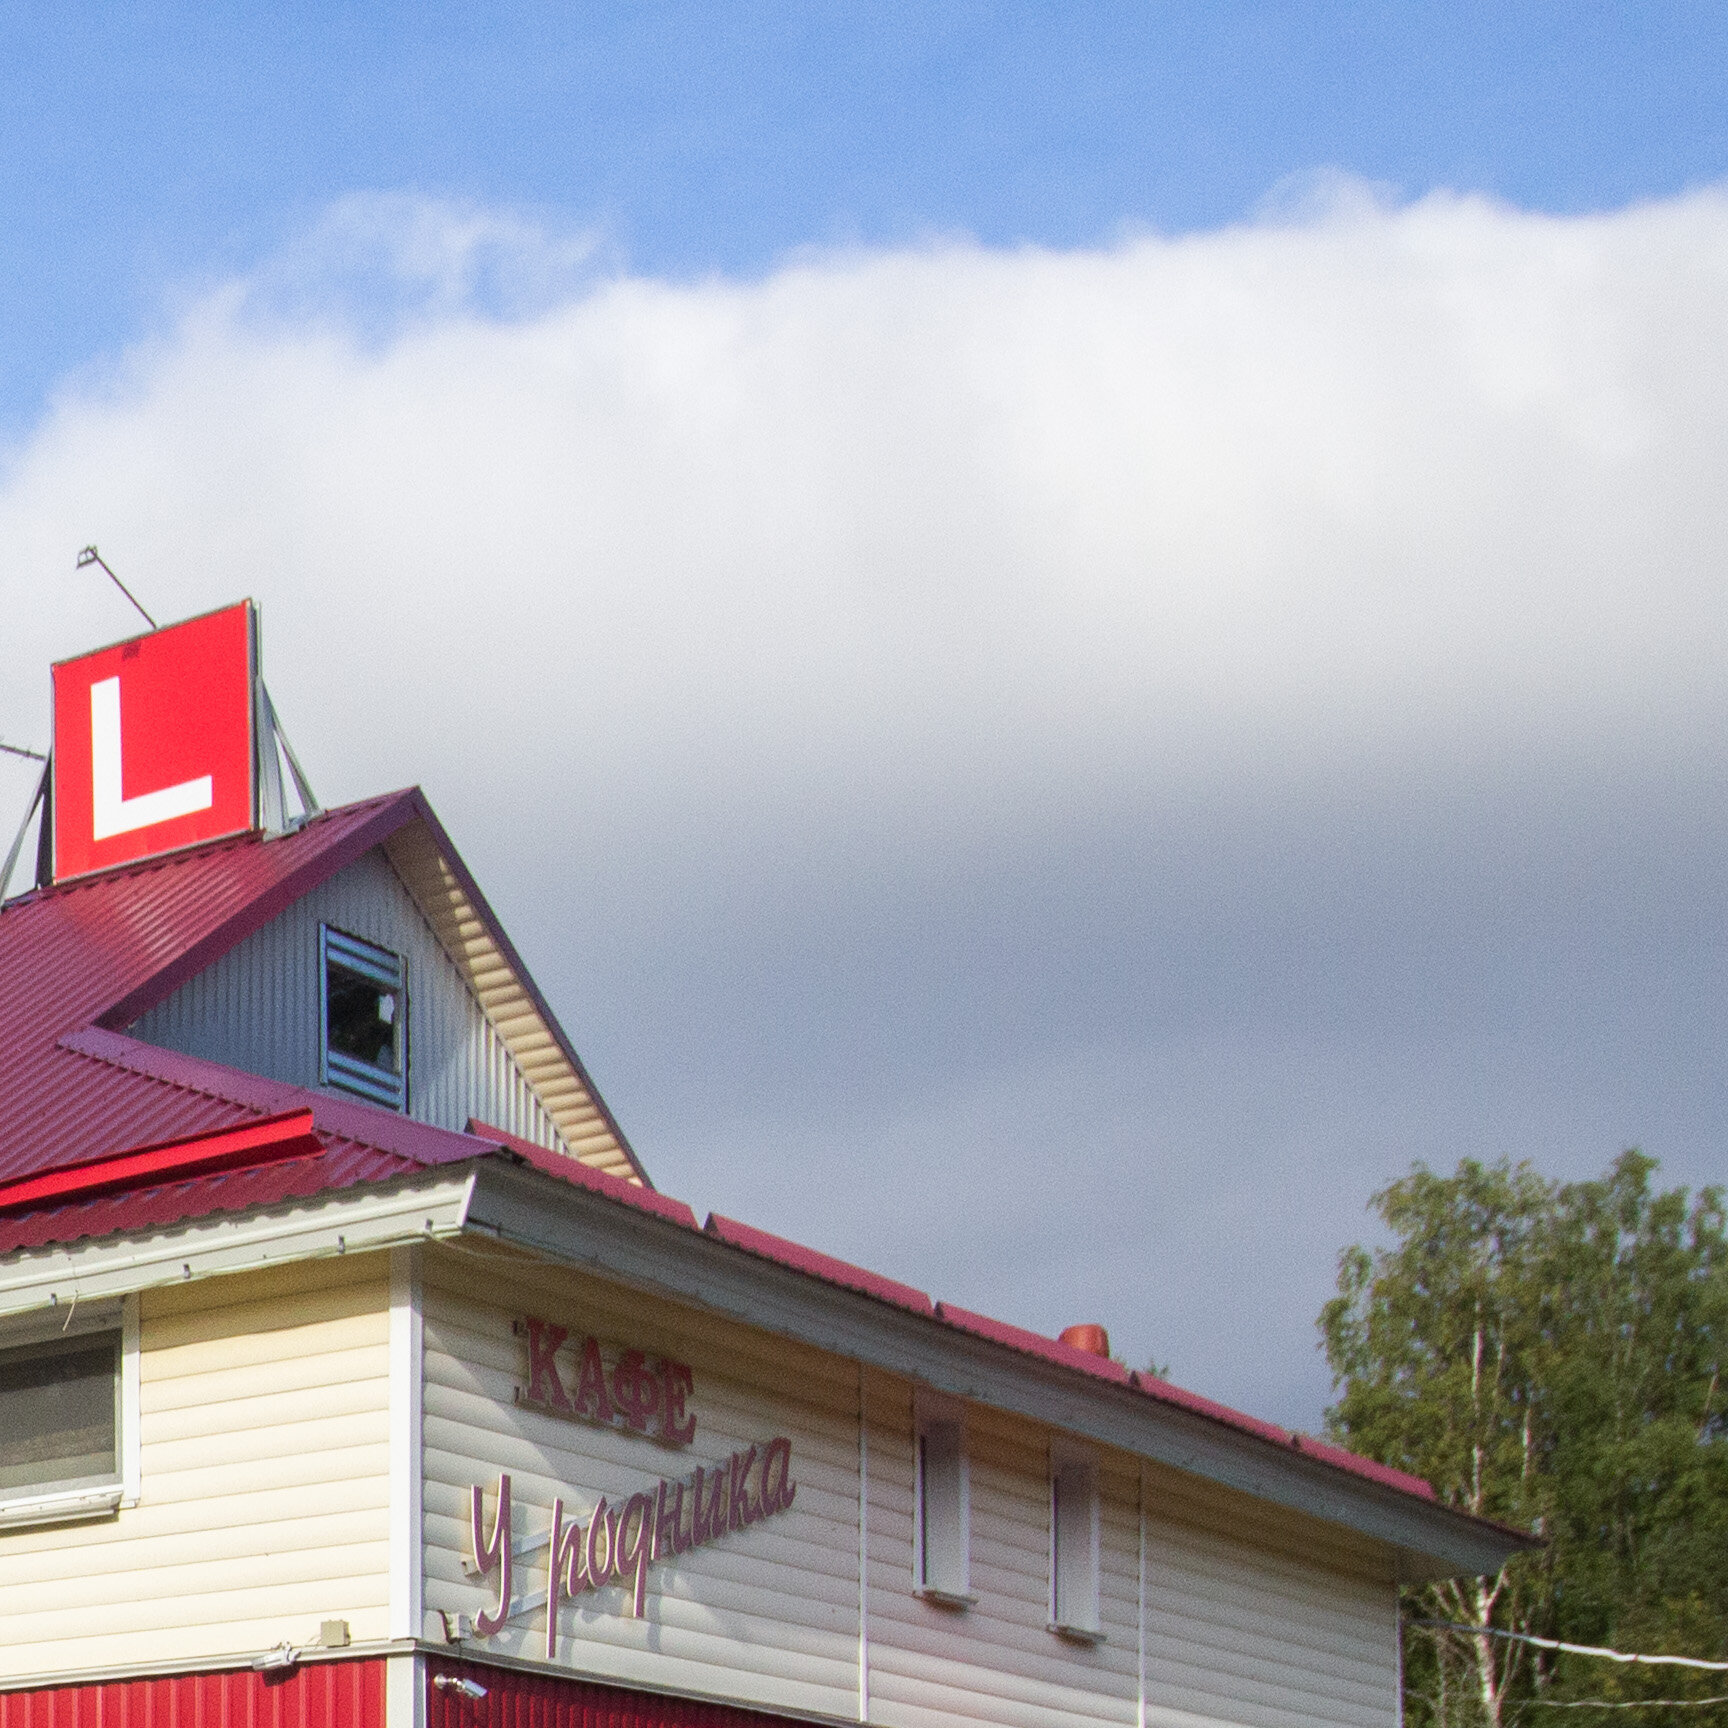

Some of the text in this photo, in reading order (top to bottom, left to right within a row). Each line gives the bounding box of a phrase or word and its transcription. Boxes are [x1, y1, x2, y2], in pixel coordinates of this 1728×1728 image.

[525, 1317, 697, 1444] КАФЕ
[471, 1437, 796, 1659] У родника
